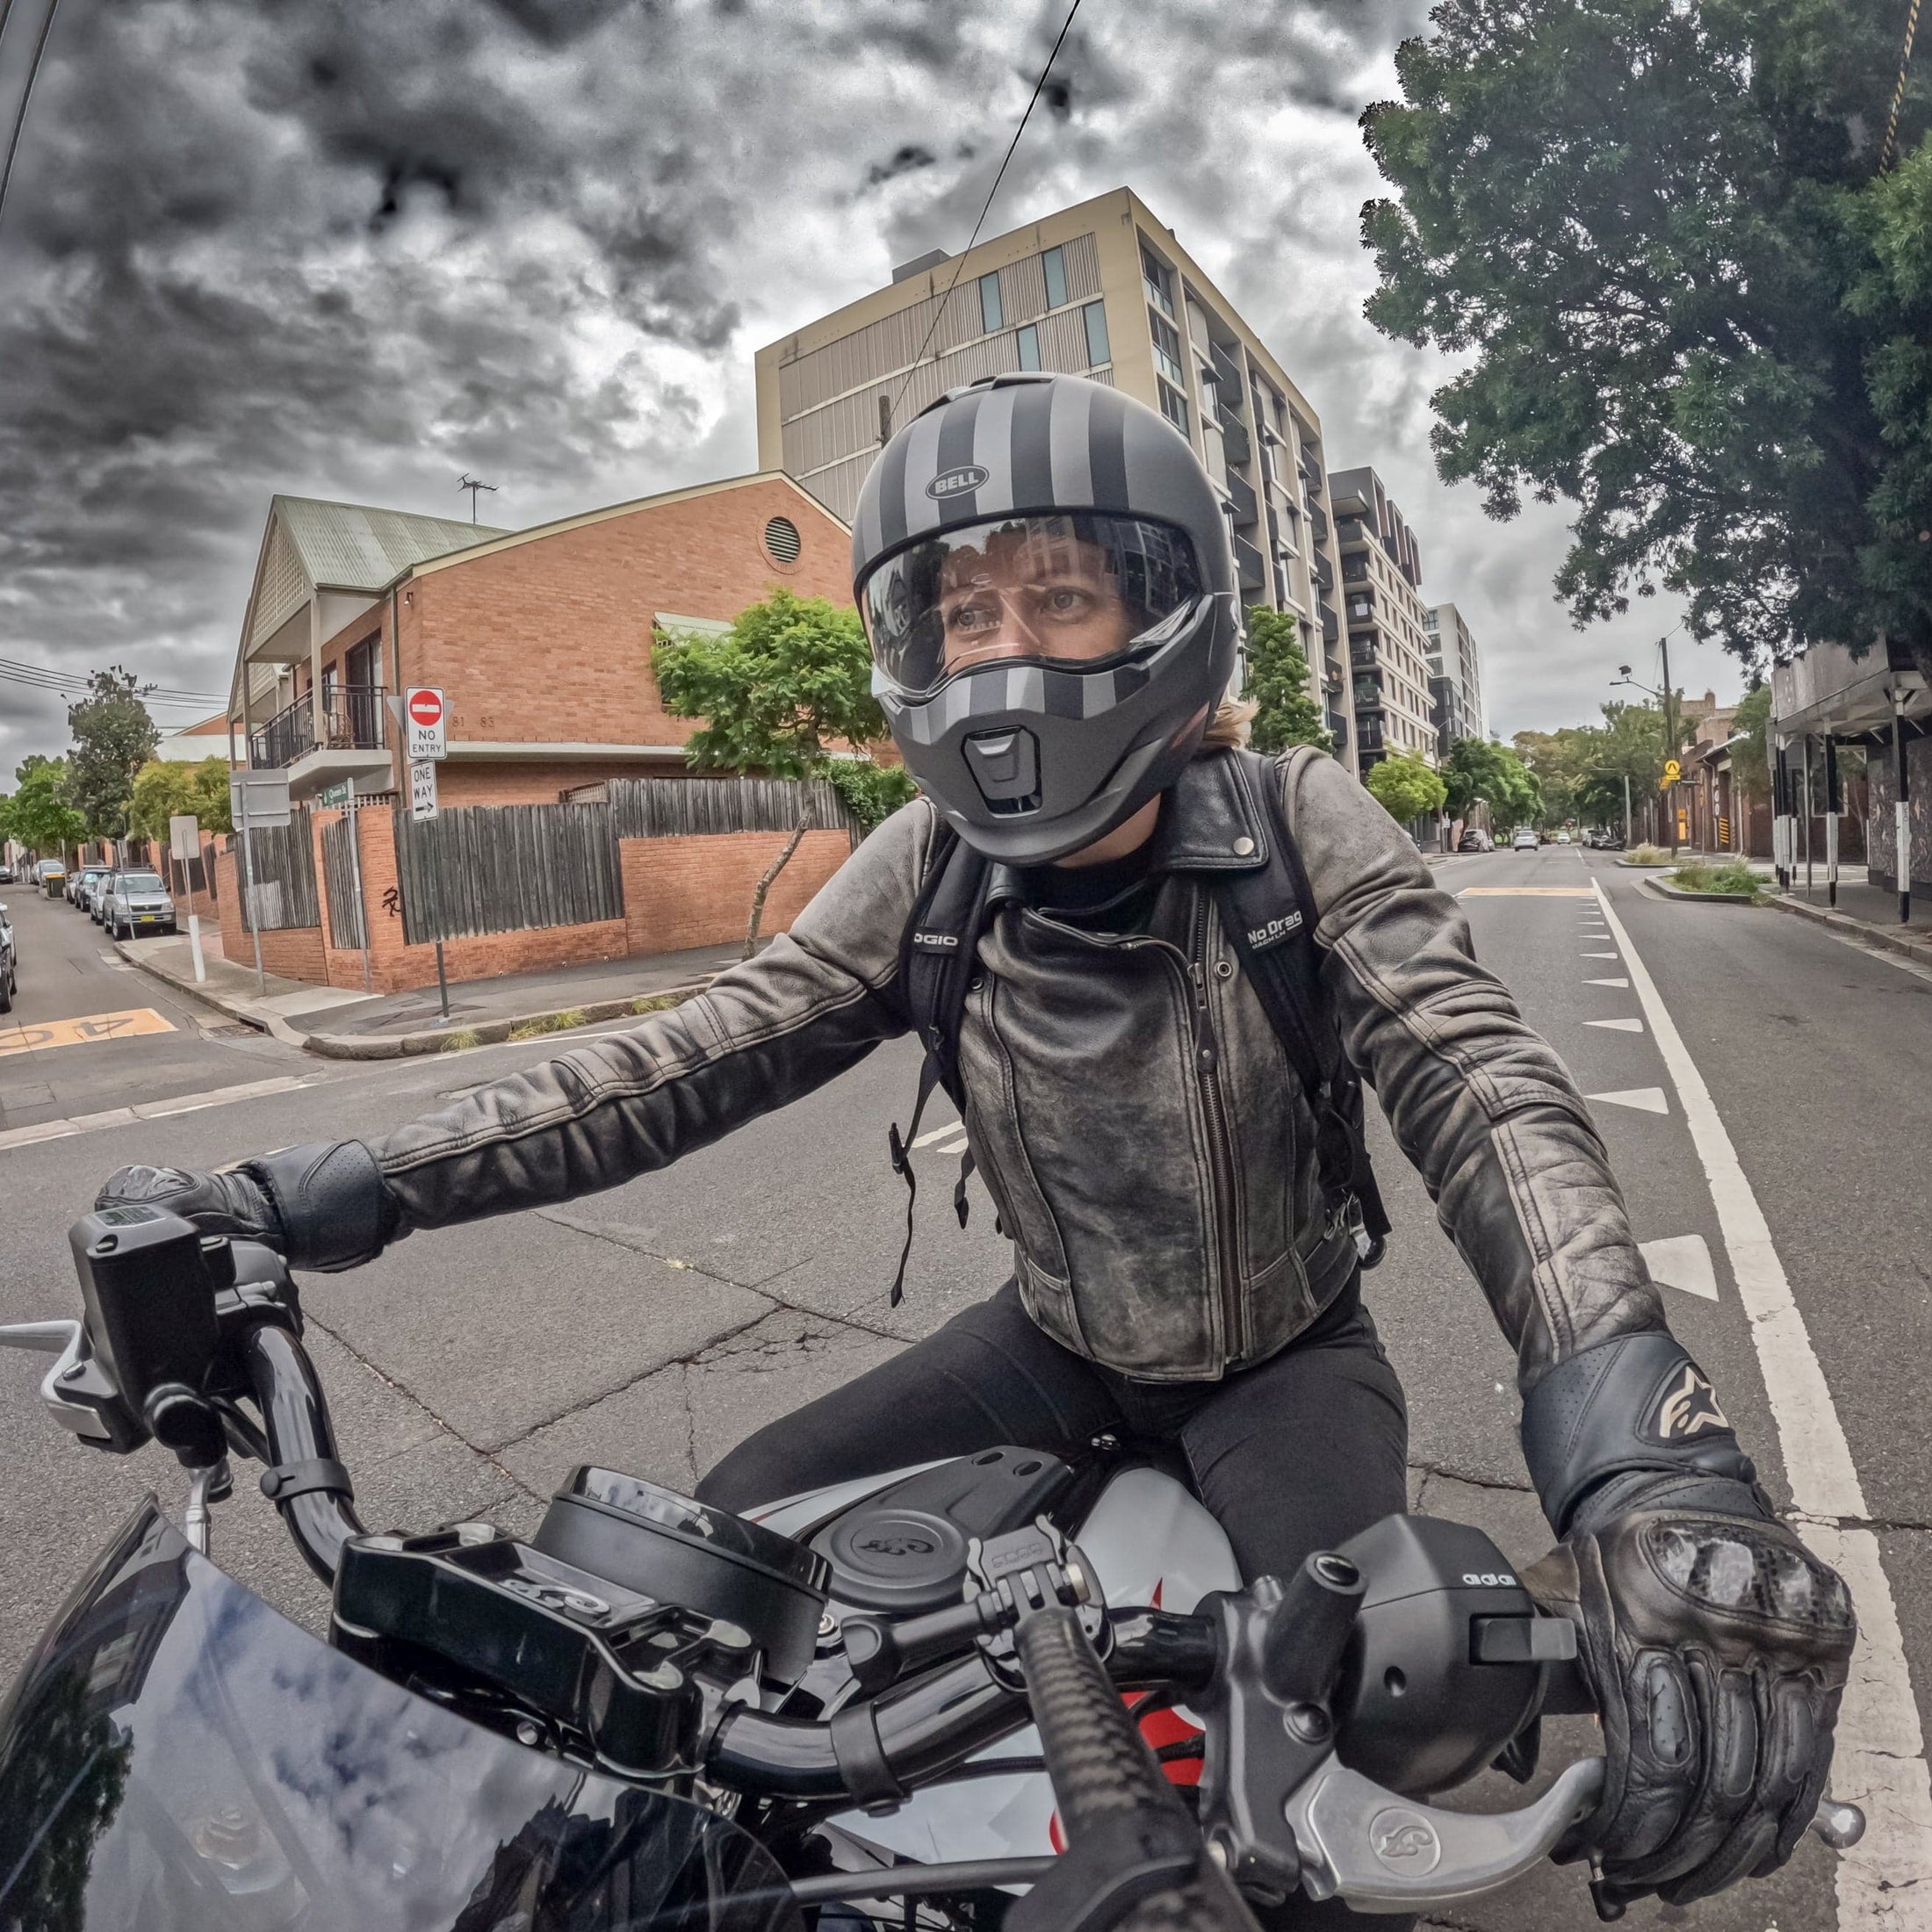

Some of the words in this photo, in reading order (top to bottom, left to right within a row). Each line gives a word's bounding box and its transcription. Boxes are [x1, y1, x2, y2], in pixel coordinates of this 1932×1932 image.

[934, 472, 979, 494] BELL
[418, 730, 436, 740] NO
[412, 744, 442, 753] ENTRY
[414, 767, 431, 782] ONE
[413, 784, 433, 800] WAY
[1247, 928, 1267, 944] No
[1267, 910, 1303, 935] Drag
